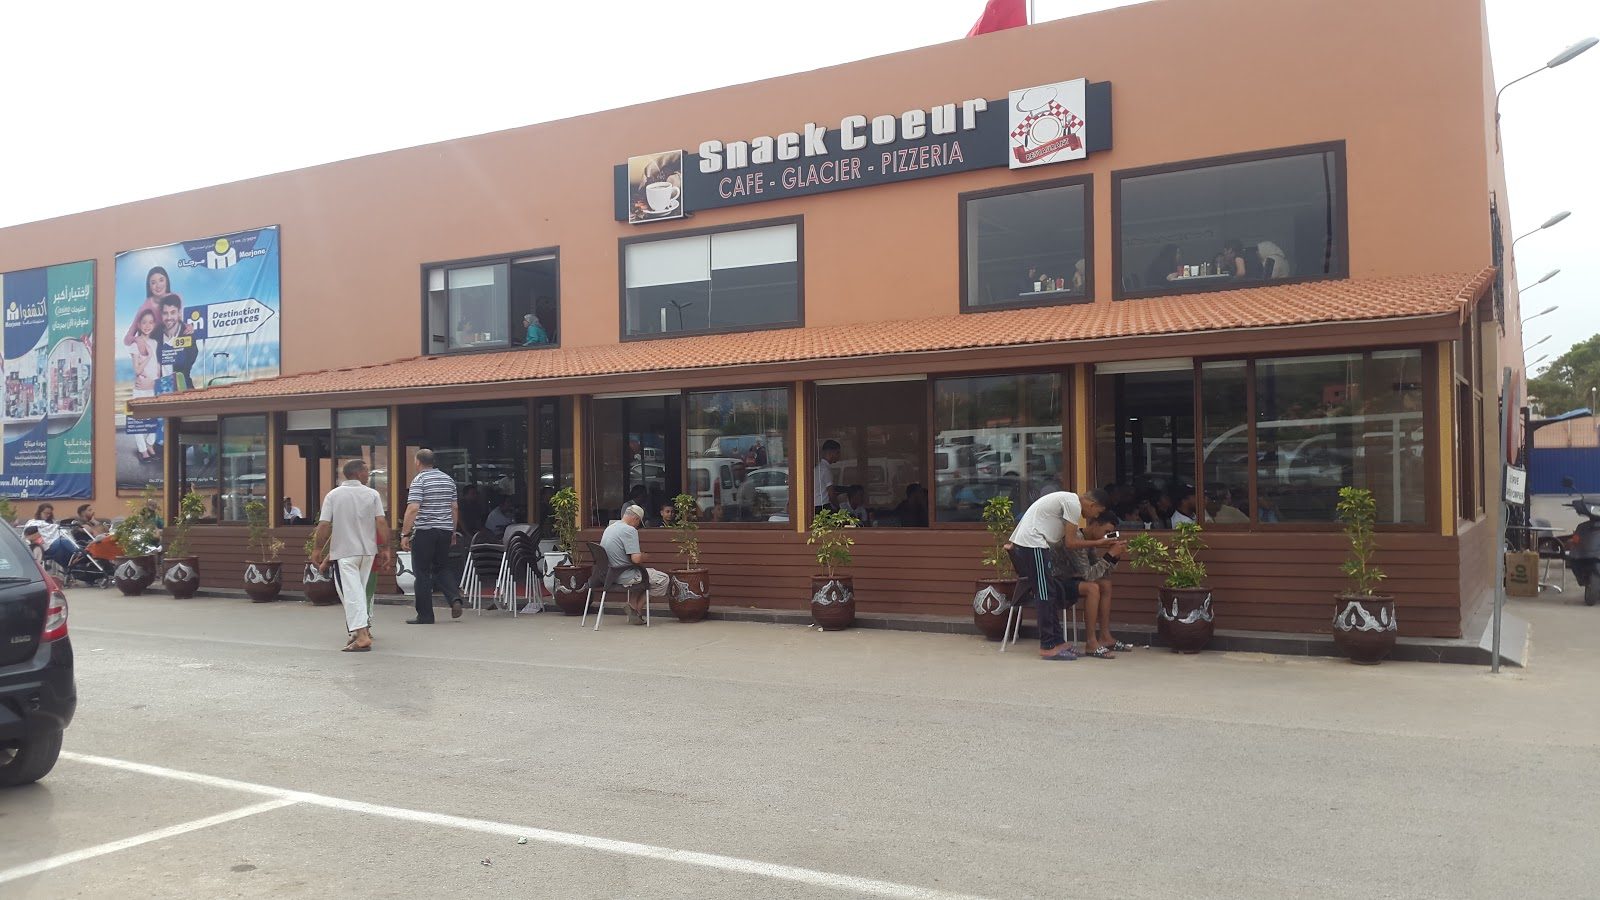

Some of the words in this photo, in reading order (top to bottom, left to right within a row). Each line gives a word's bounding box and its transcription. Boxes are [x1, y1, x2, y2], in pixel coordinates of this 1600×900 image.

[699, 122, 828, 174] Snack
[840, 97, 988, 151] Coeur
[718, 172, 764, 199] CAFE
[781, 157, 861, 190] GLACIER
[881, 140, 965, 175] PIZZERIA
[239, 248, 266, 258] Marjane
[212, 307, 260, 319] Destination
[212, 314, 260, 328] Vacances
[175, 338, 185, 347] 89
